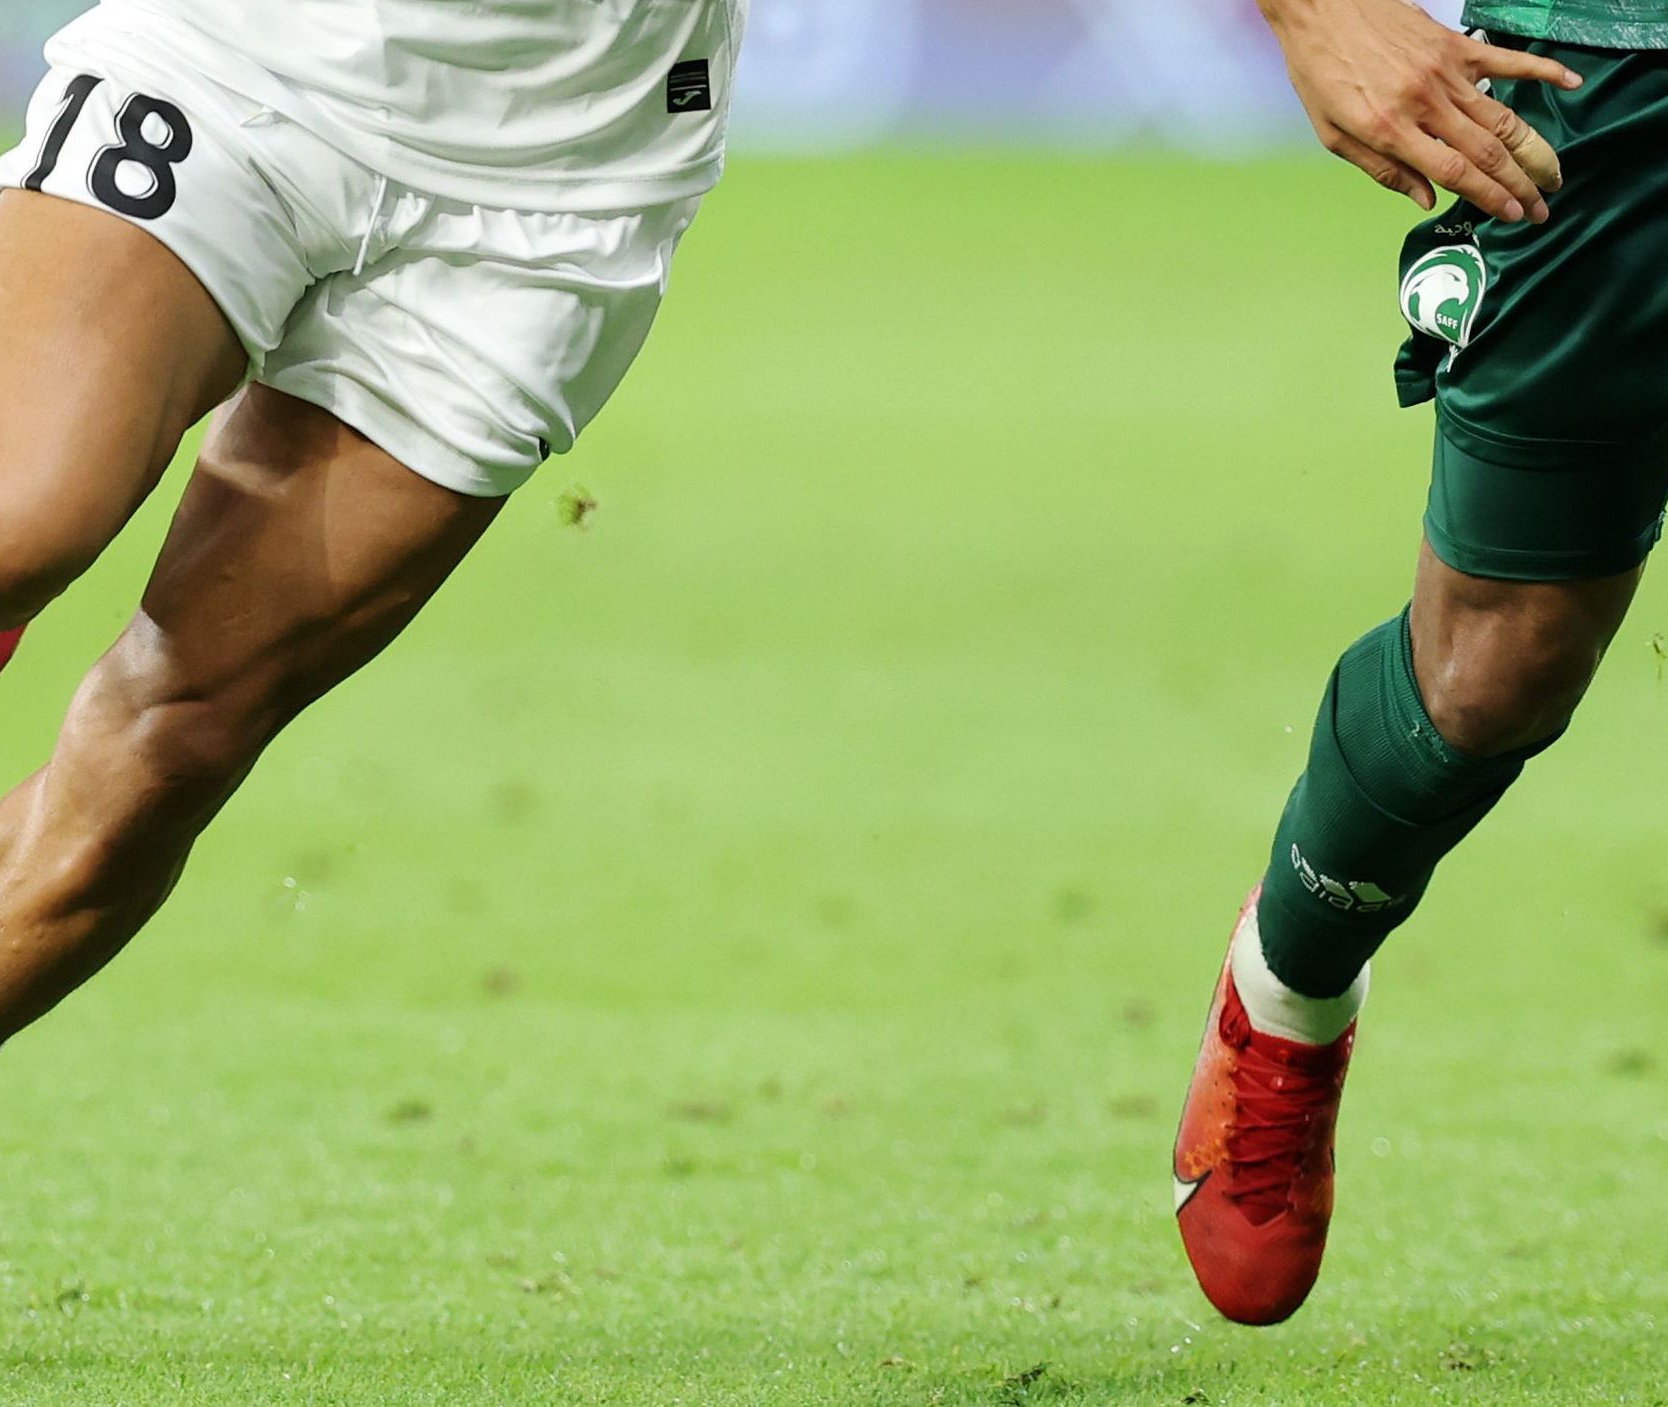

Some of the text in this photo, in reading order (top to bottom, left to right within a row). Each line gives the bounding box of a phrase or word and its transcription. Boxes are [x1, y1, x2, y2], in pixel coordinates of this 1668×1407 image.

[20, 73, 194, 221] 18
[1436, 313, 1459, 330] SAFF
[1291, 842, 1406, 912] adida
